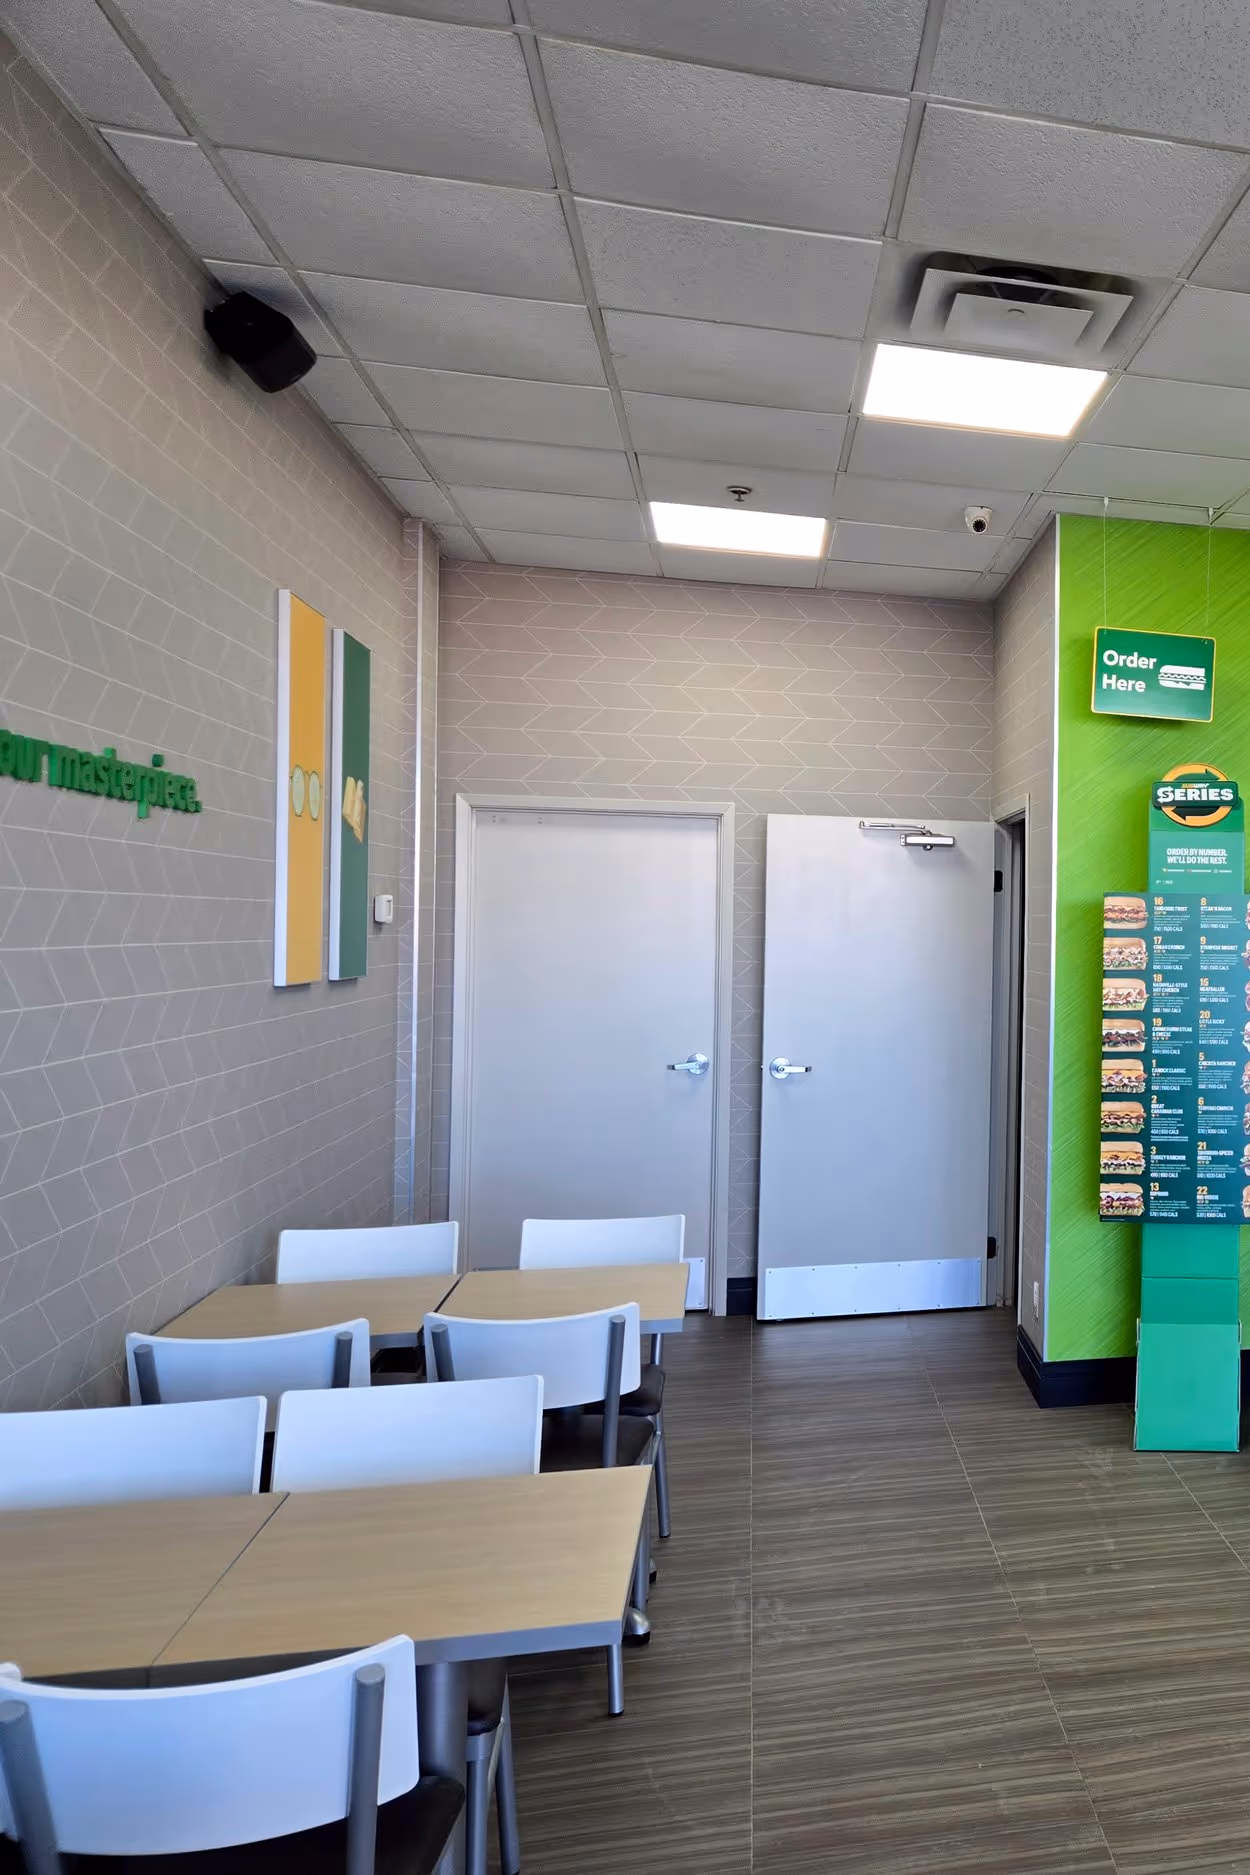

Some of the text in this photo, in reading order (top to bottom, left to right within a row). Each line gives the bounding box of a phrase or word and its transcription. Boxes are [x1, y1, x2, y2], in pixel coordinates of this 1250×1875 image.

[1103, 650, 1157, 669] Order
[1102, 674, 1146, 692] Here
[1157, 786, 1233, 803] SERIES
[1167, 856, 1186, 864] WE'LL
[1187, 856, 1197, 864] DO
[1154, 897, 1163, 905] 16
[1201, 897, 1206, 905] 8
[1153, 936, 1162, 944] 17
[1200, 936, 1206, 944] 9
[1153, 974, 1162, 982] 18
[1200, 978, 1209, 986] 15
[1152, 1018, 1161, 1026] 19
[1151, 1095, 1157, 1103] 2
[1198, 1097, 1204, 1105] 6
[1151, 1146, 1156, 1154] 3
[1198, 1142, 1206, 1150] 21
[1150, 1183, 1159, 1191] 13
[1197, 1186, 1207, 1194] 22
